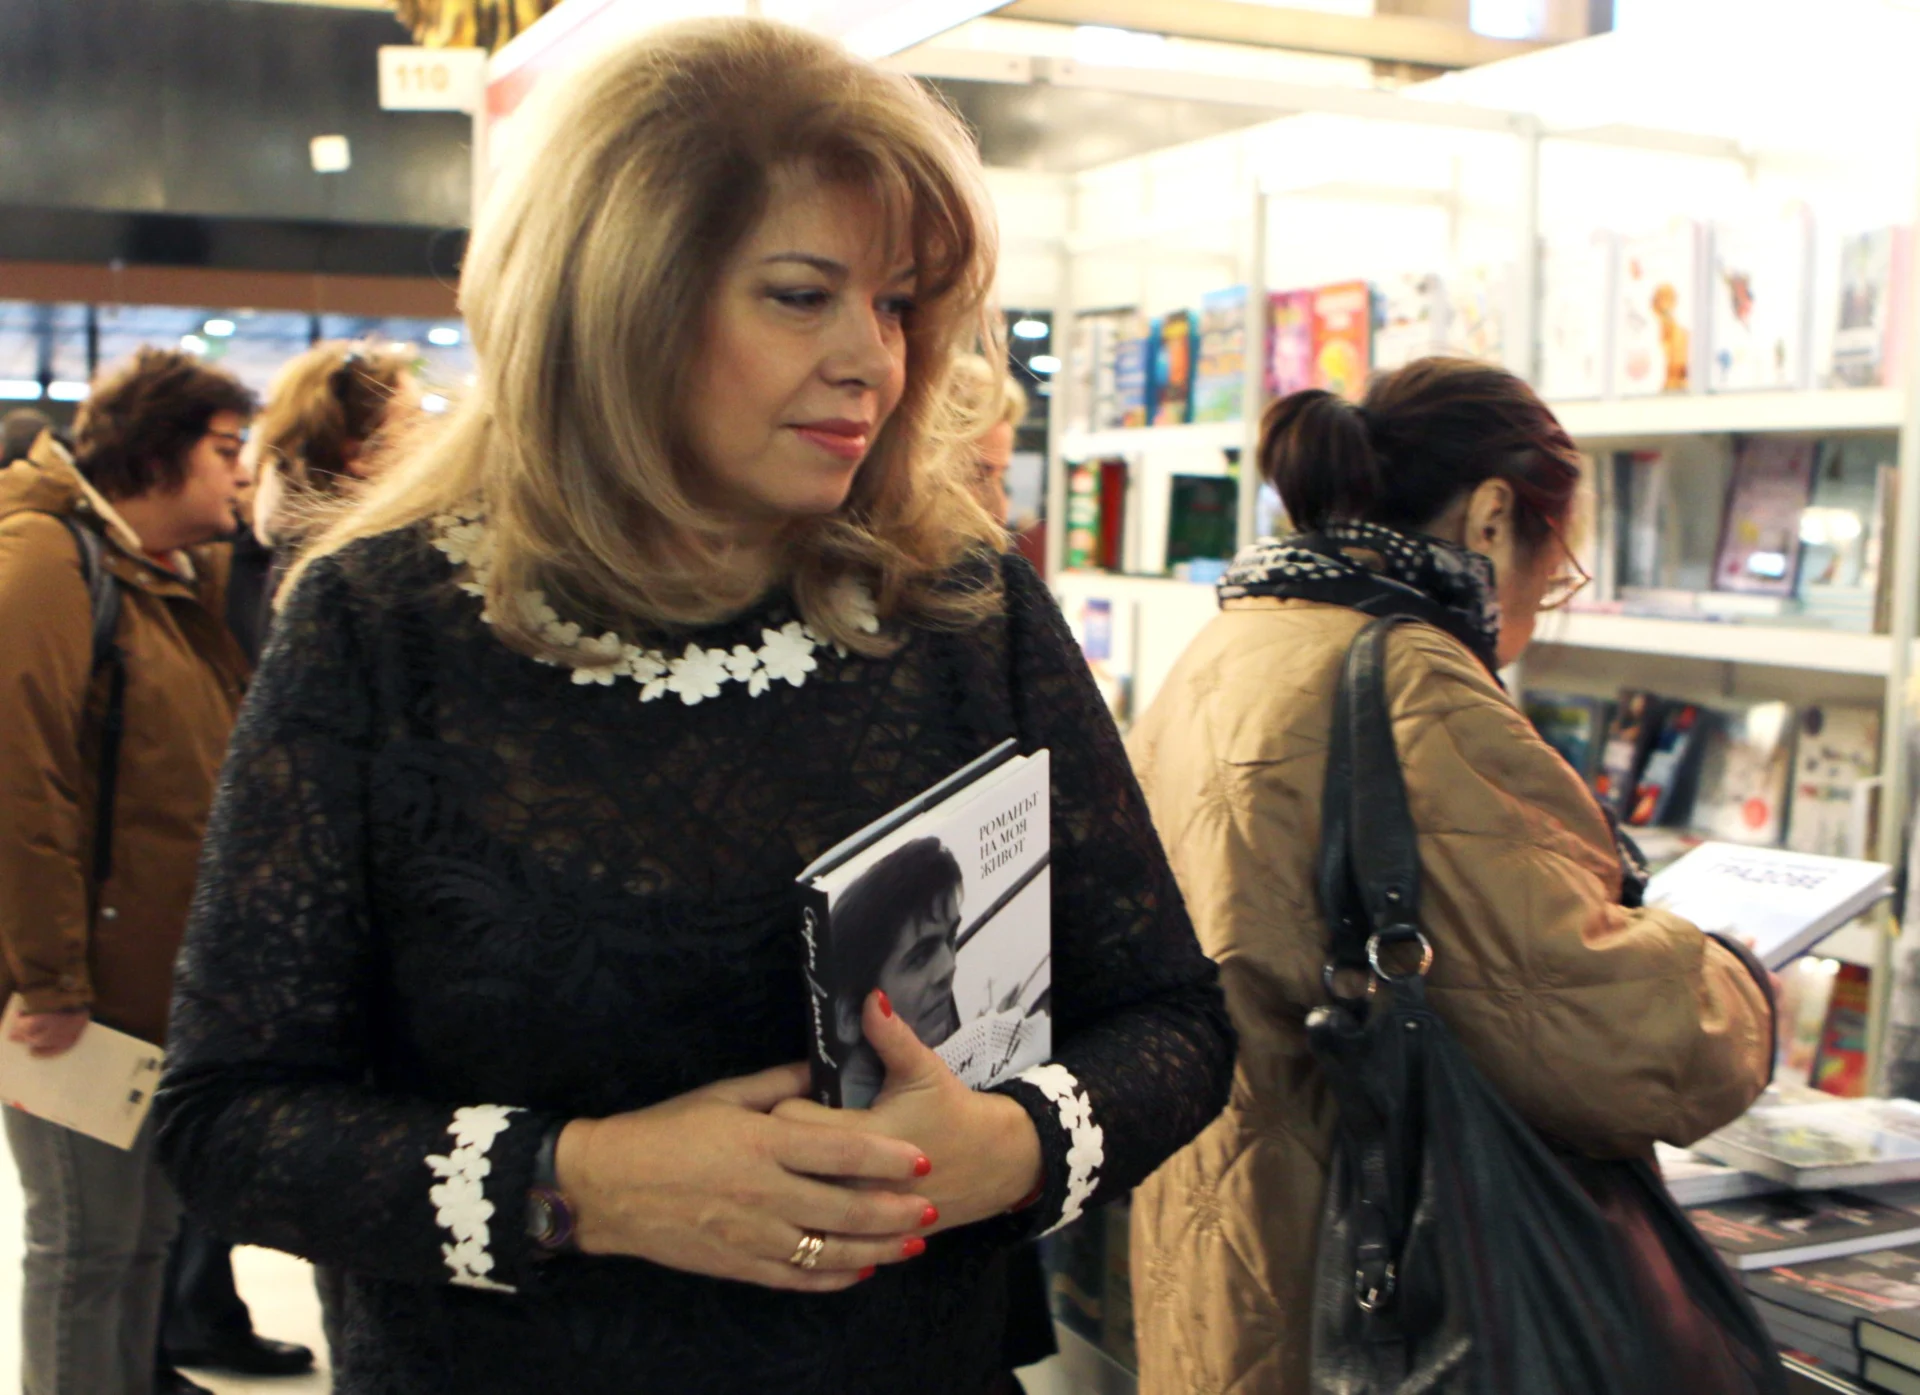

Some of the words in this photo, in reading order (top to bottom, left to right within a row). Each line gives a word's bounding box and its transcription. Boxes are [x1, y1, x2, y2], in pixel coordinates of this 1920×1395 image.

[395, 63, 449, 93] 110
[979, 790, 1039, 841] РОМАНЪТ
[980, 839, 997, 861] НА
[1000, 818, 1027, 845] МОЯ
[980, 838, 1026, 879] ЖИВОТ
